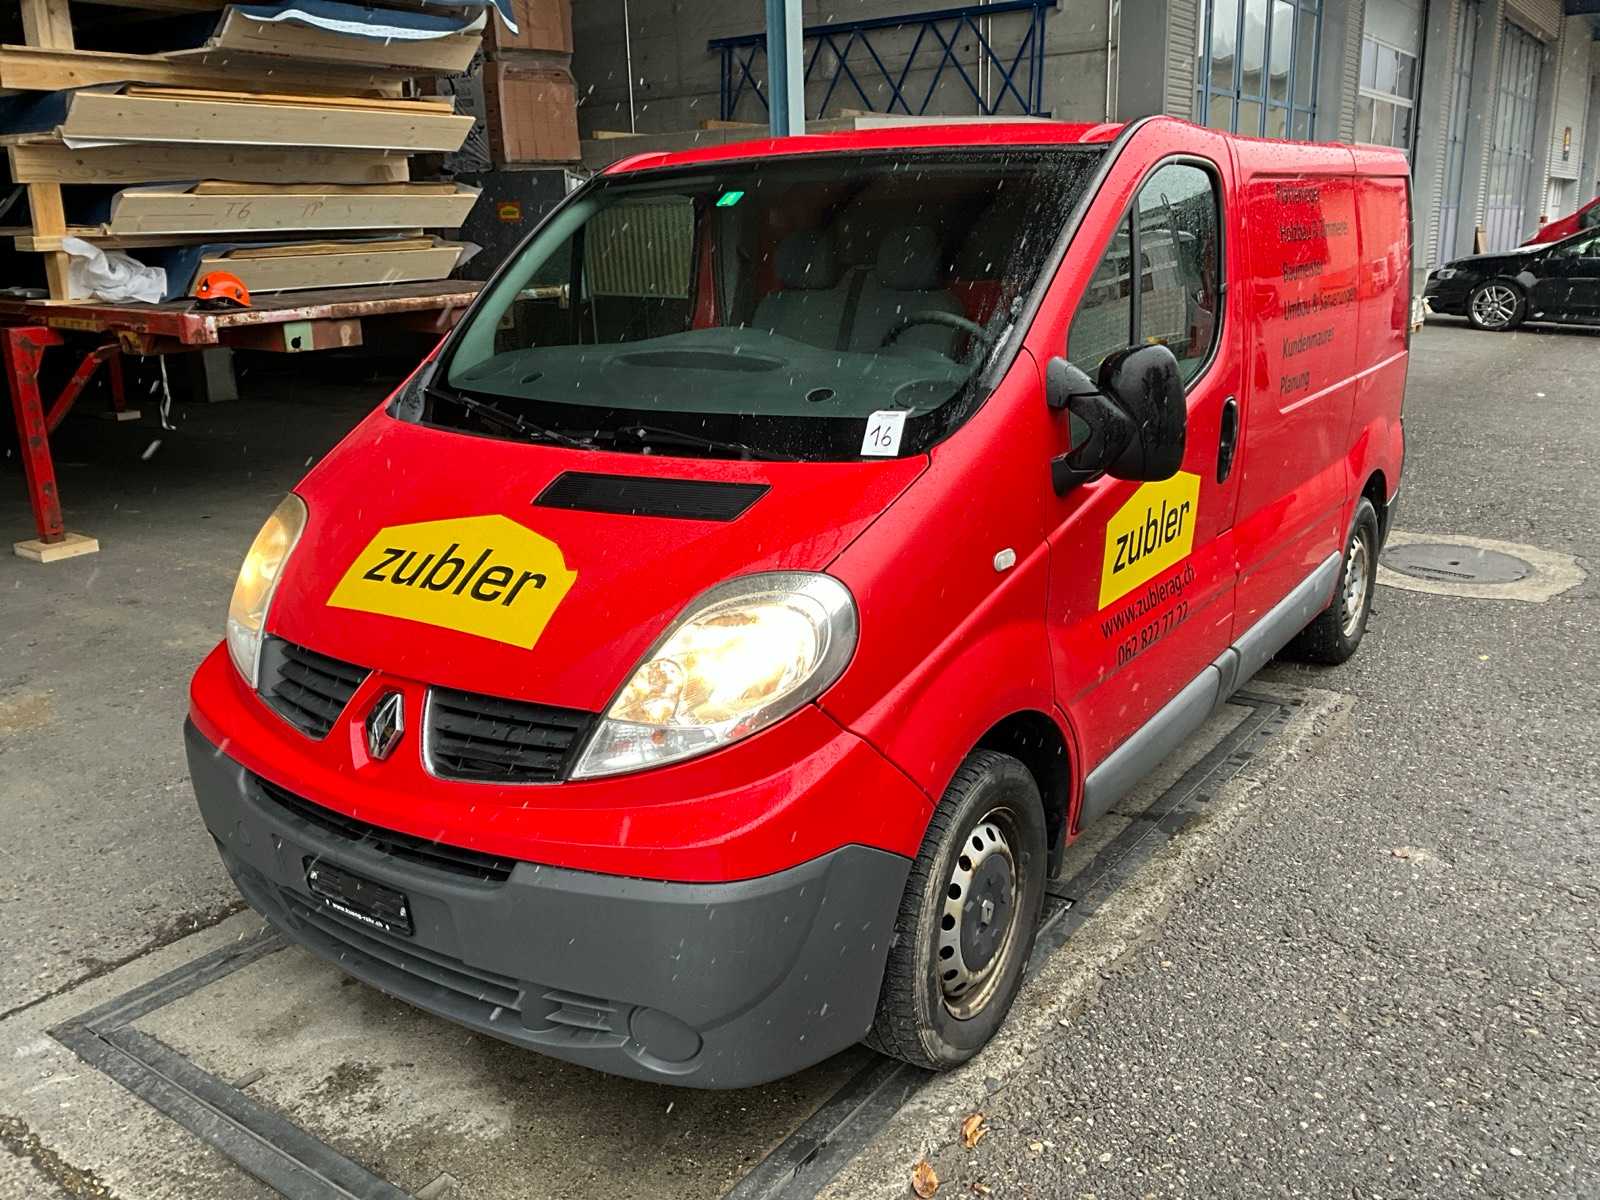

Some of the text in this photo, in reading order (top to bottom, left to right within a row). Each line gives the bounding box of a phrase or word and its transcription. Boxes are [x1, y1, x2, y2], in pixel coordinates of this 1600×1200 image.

[1283, 262, 1322, 282] Baumeister
[1284, 297, 1310, 320] Umbau
[1312, 294, 1319, 313] &
[1282, 328, 1334, 359] Kundenmaurer
[1280, 370, 1309, 397] Planung
[870, 425, 892, 447] 16
[1113, 500, 1190, 574] zubler
[362, 543, 547, 607] zubler
[1101, 563, 1195, 638] www.zublerag.ch
[1118, 600, 1189, 666] 062 822 77 22
